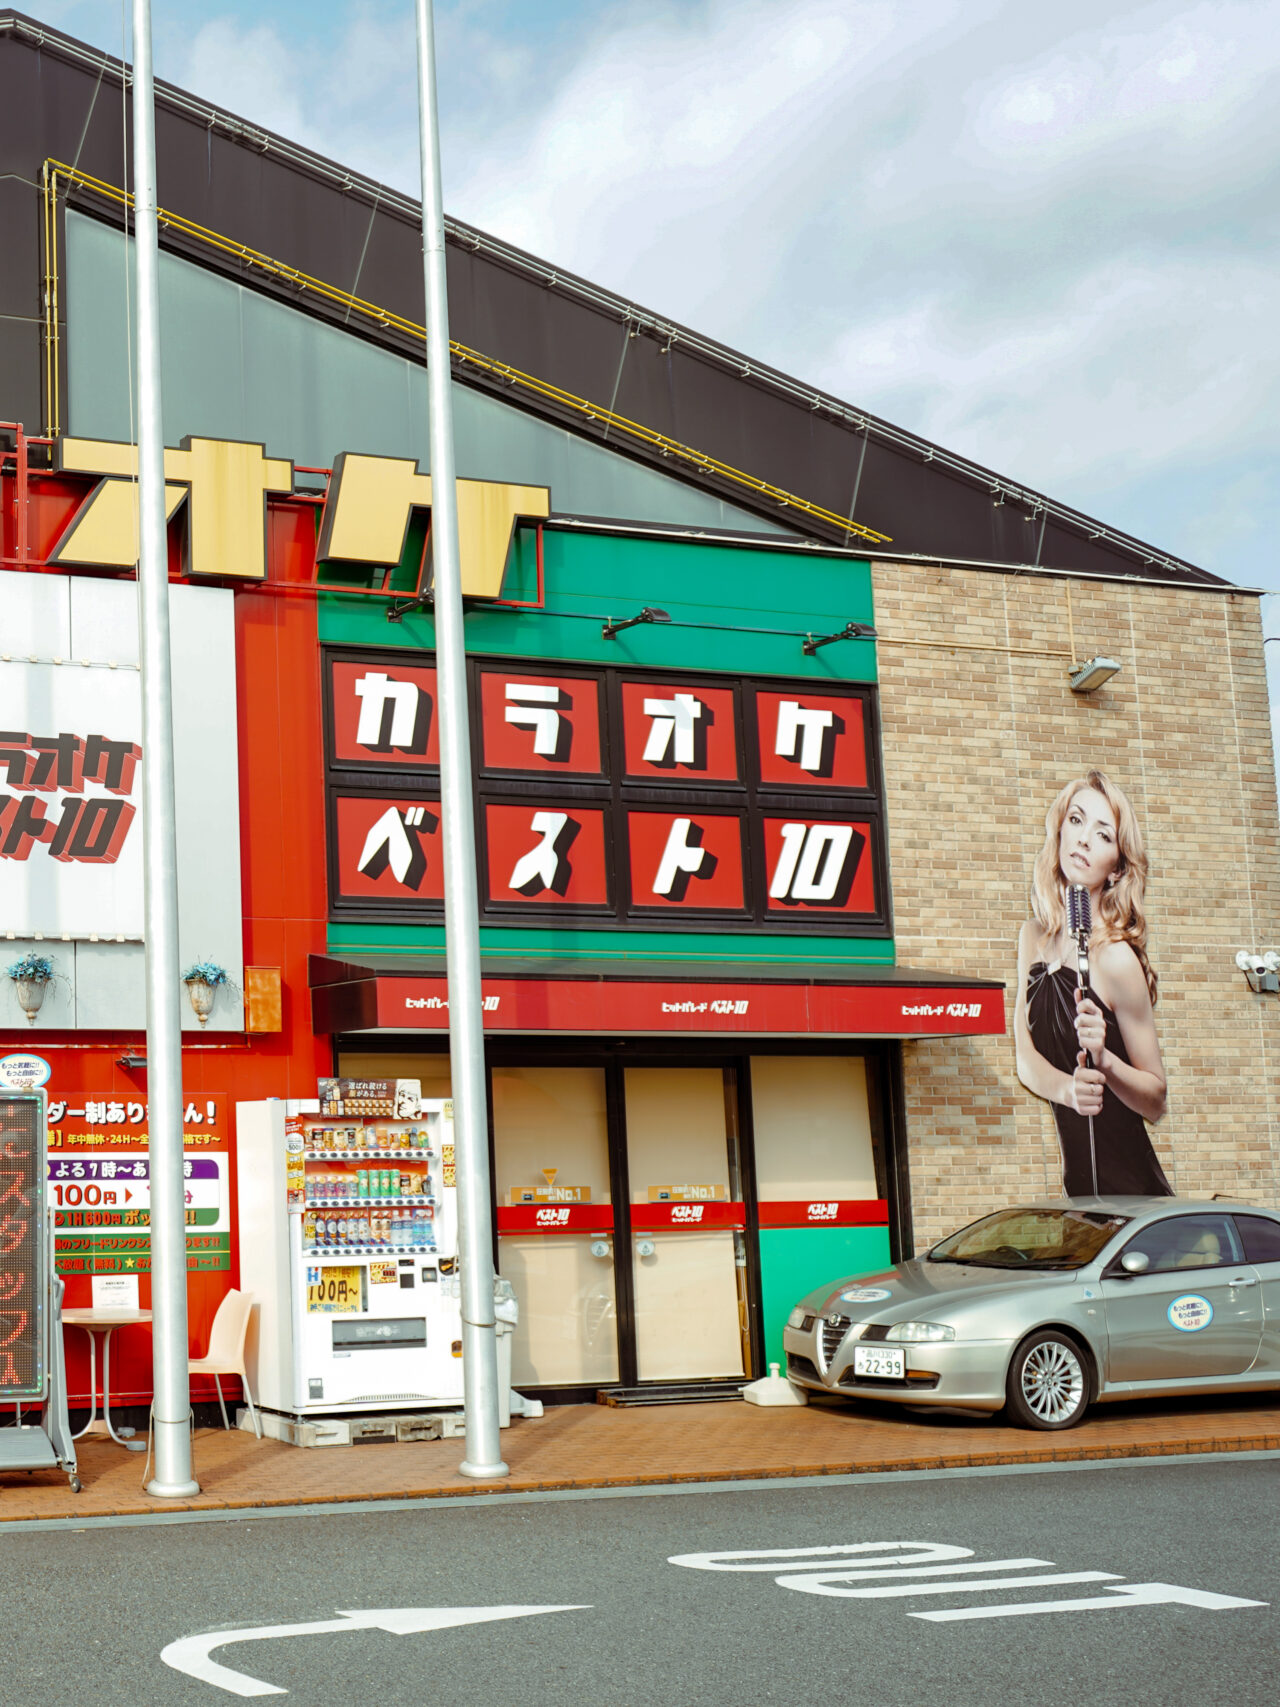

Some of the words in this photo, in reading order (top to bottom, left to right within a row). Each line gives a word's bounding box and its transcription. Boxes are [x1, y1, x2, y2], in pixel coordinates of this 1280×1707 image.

[355, 672, 833, 770] カラオケ
[357, 806, 853, 900] ベスト10
[406, 997, 450, 1008] ヒットパレー
[710, 1000, 748, 1014] ベスト10
[946, 1003, 981, 1017] ベスト10
[53, 1184, 117, 1207] 100円
